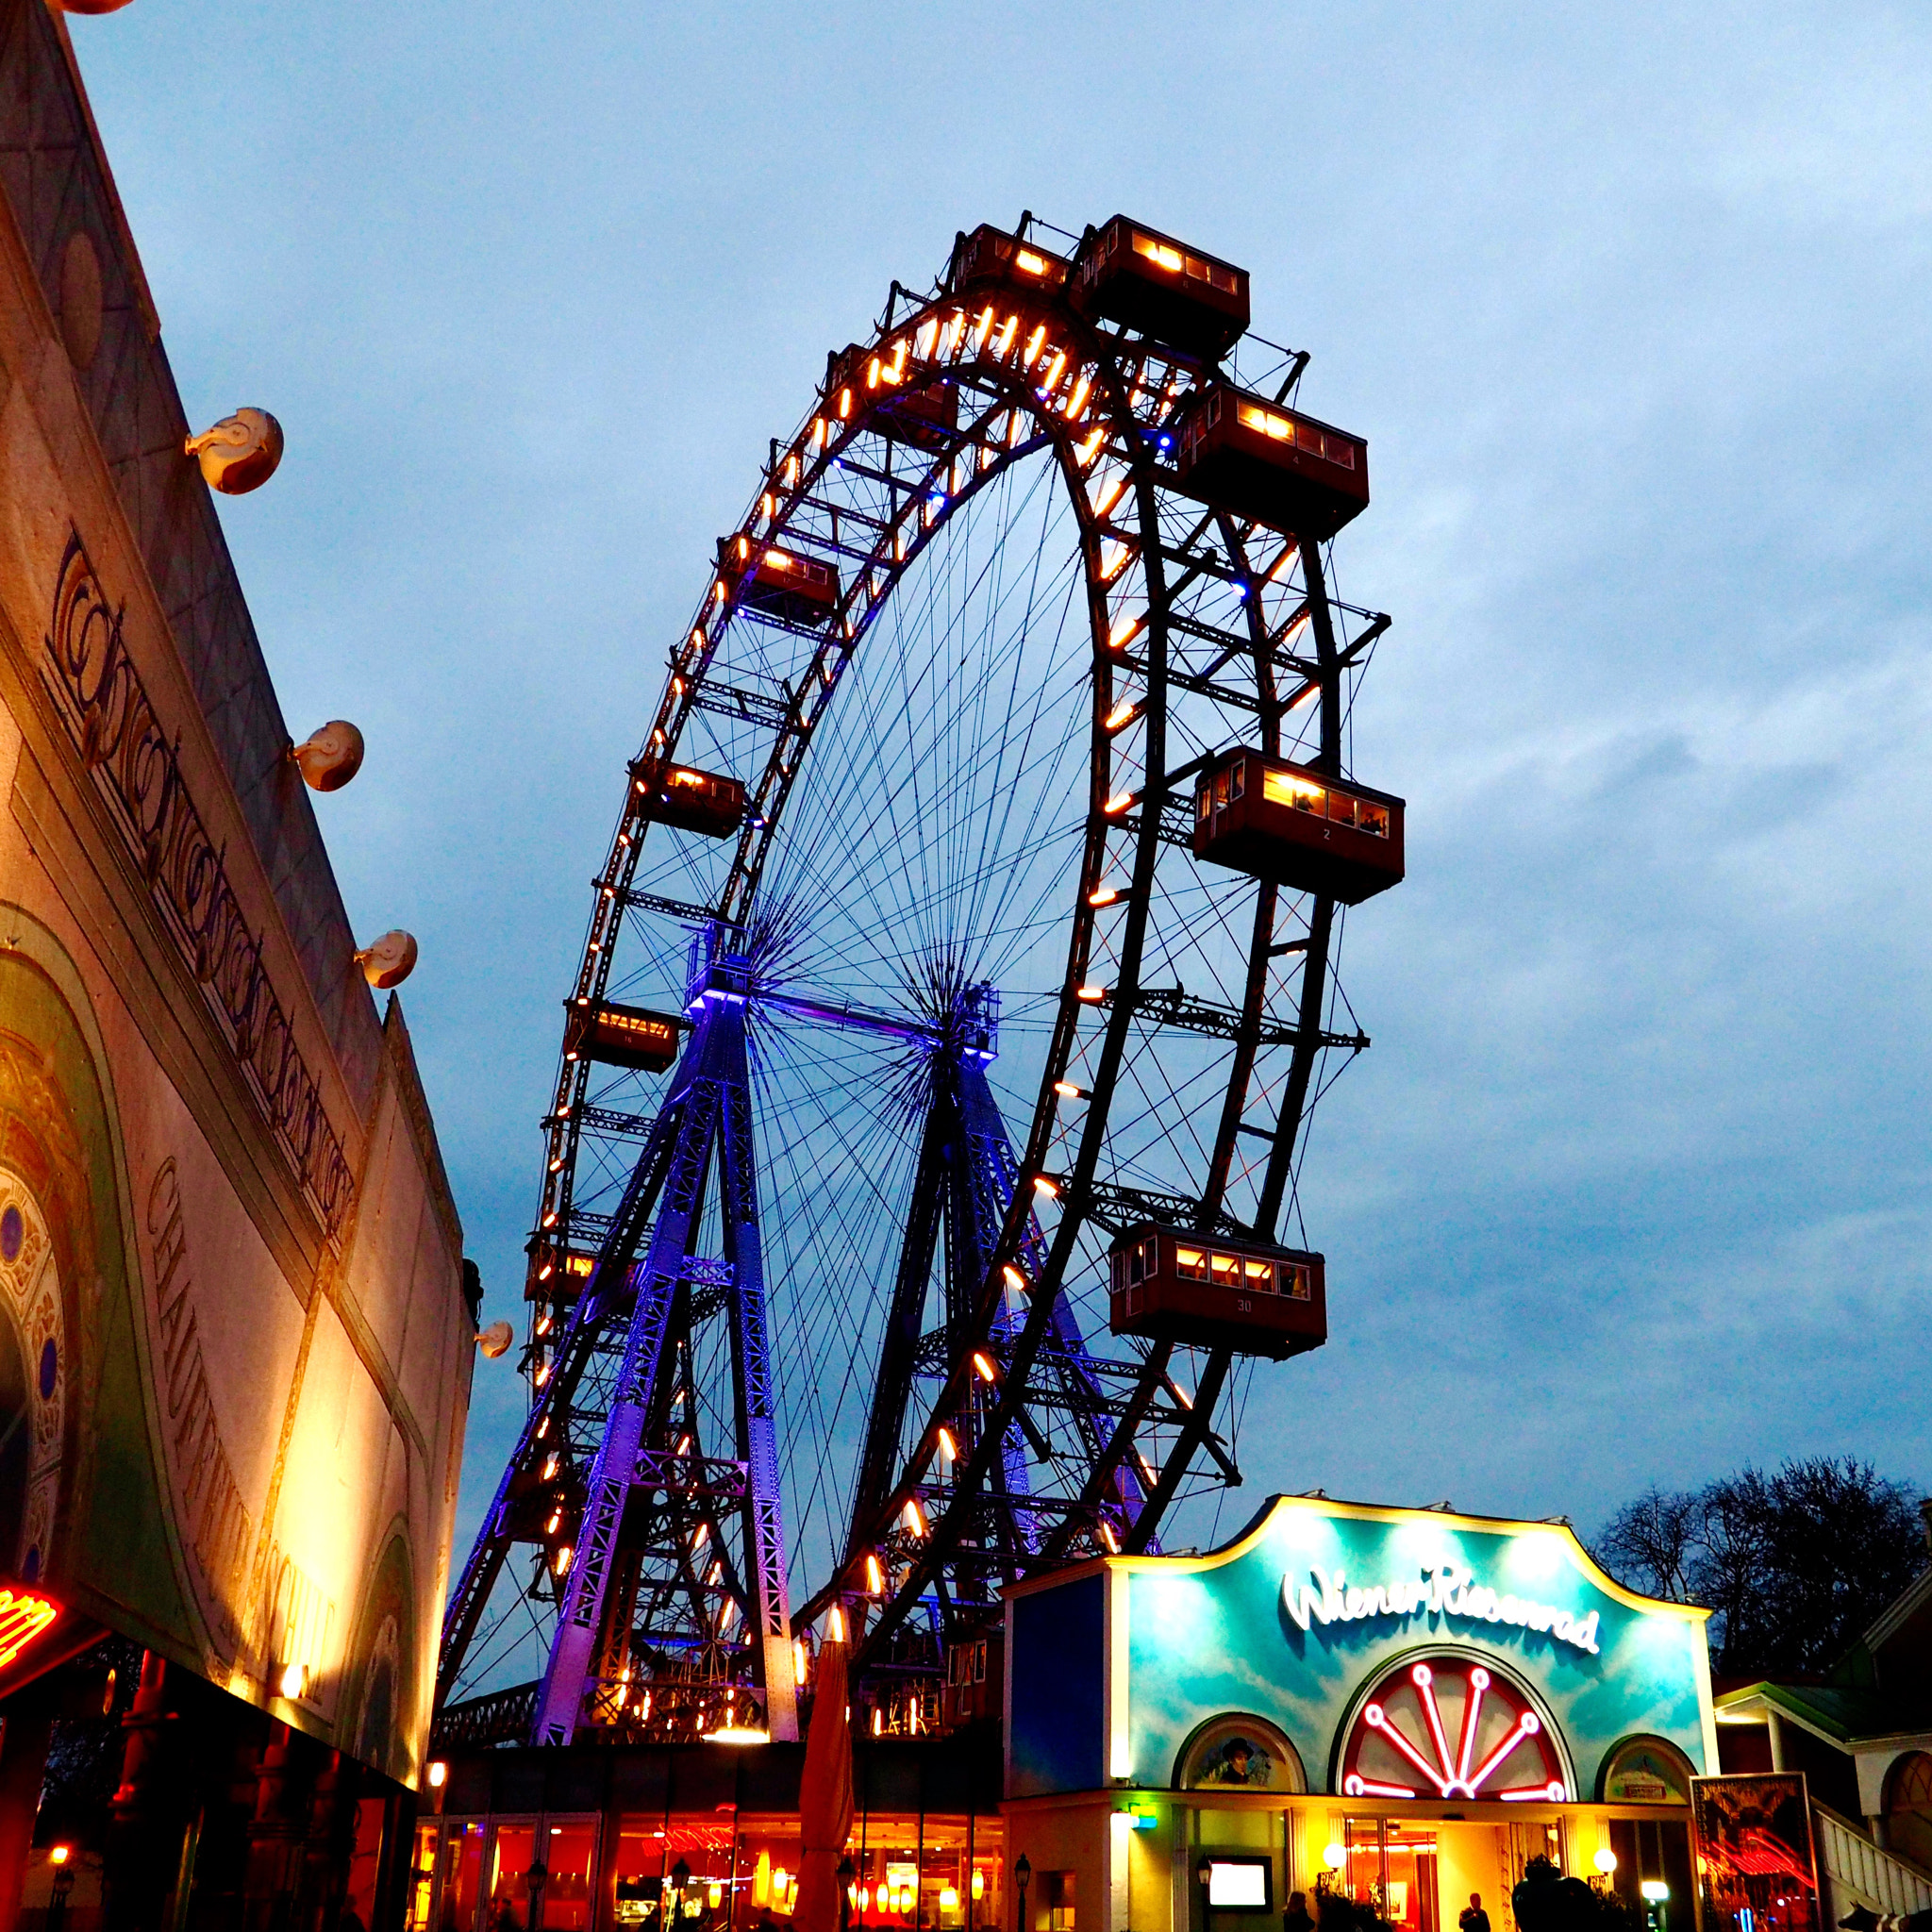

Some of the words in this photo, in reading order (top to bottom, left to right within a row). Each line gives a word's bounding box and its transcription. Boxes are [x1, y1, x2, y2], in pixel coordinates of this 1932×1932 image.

[1324, 828, 1330, 841] 2
[1238, 1299, 1252, 1313] 30
[1282, 1563, 1432, 1631] Wiener
[1421, 1557, 1601, 1655] Riesenrad
